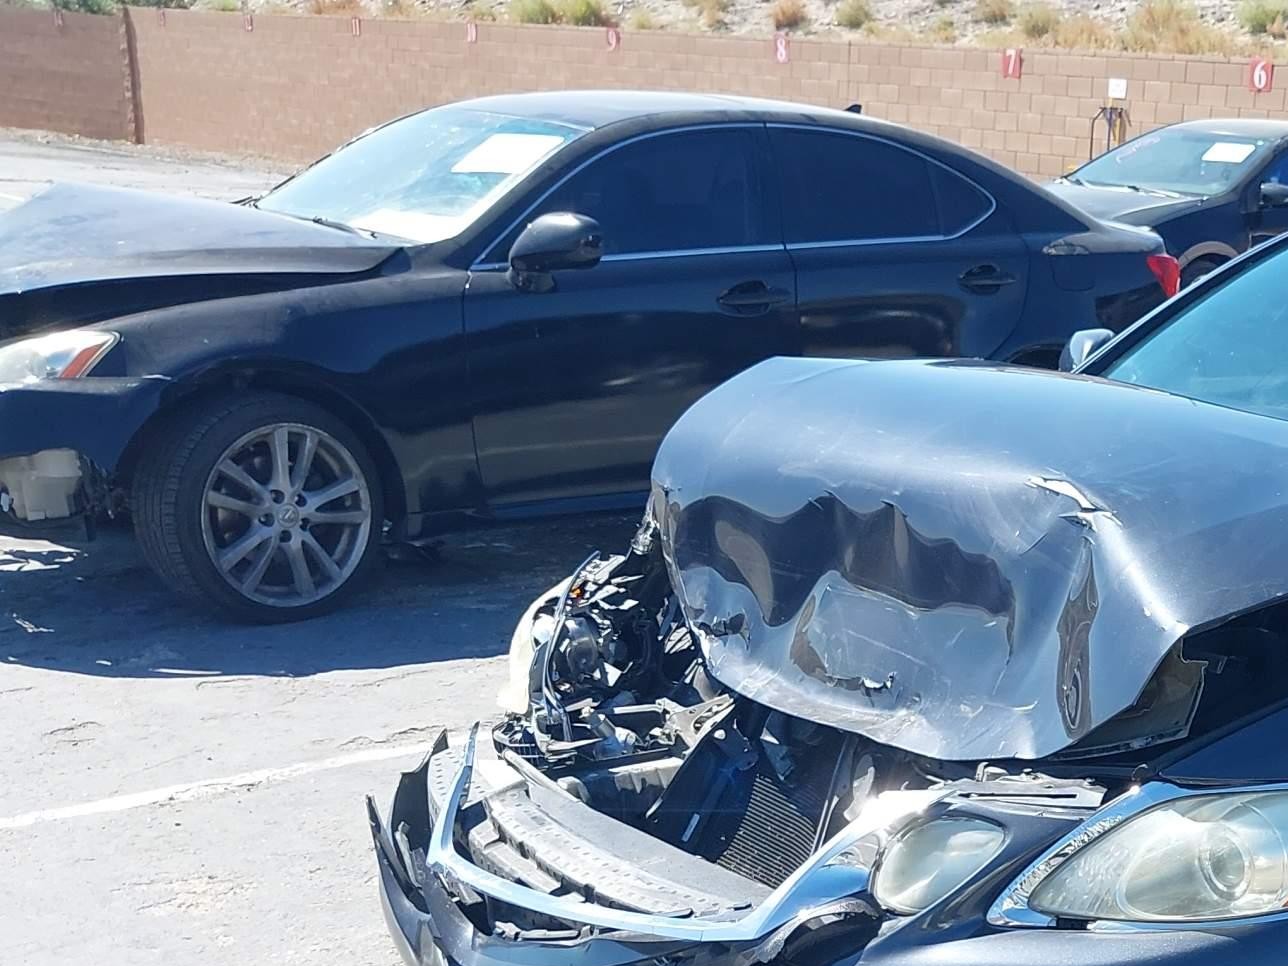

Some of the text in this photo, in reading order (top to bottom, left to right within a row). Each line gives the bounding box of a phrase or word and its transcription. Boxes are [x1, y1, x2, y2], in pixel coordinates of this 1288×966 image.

[608, 31, 618, 52] 9
[777, 38, 786, 62] 8
[1006, 49, 1017, 74] 7
[1253, 61, 1268, 89] 6
